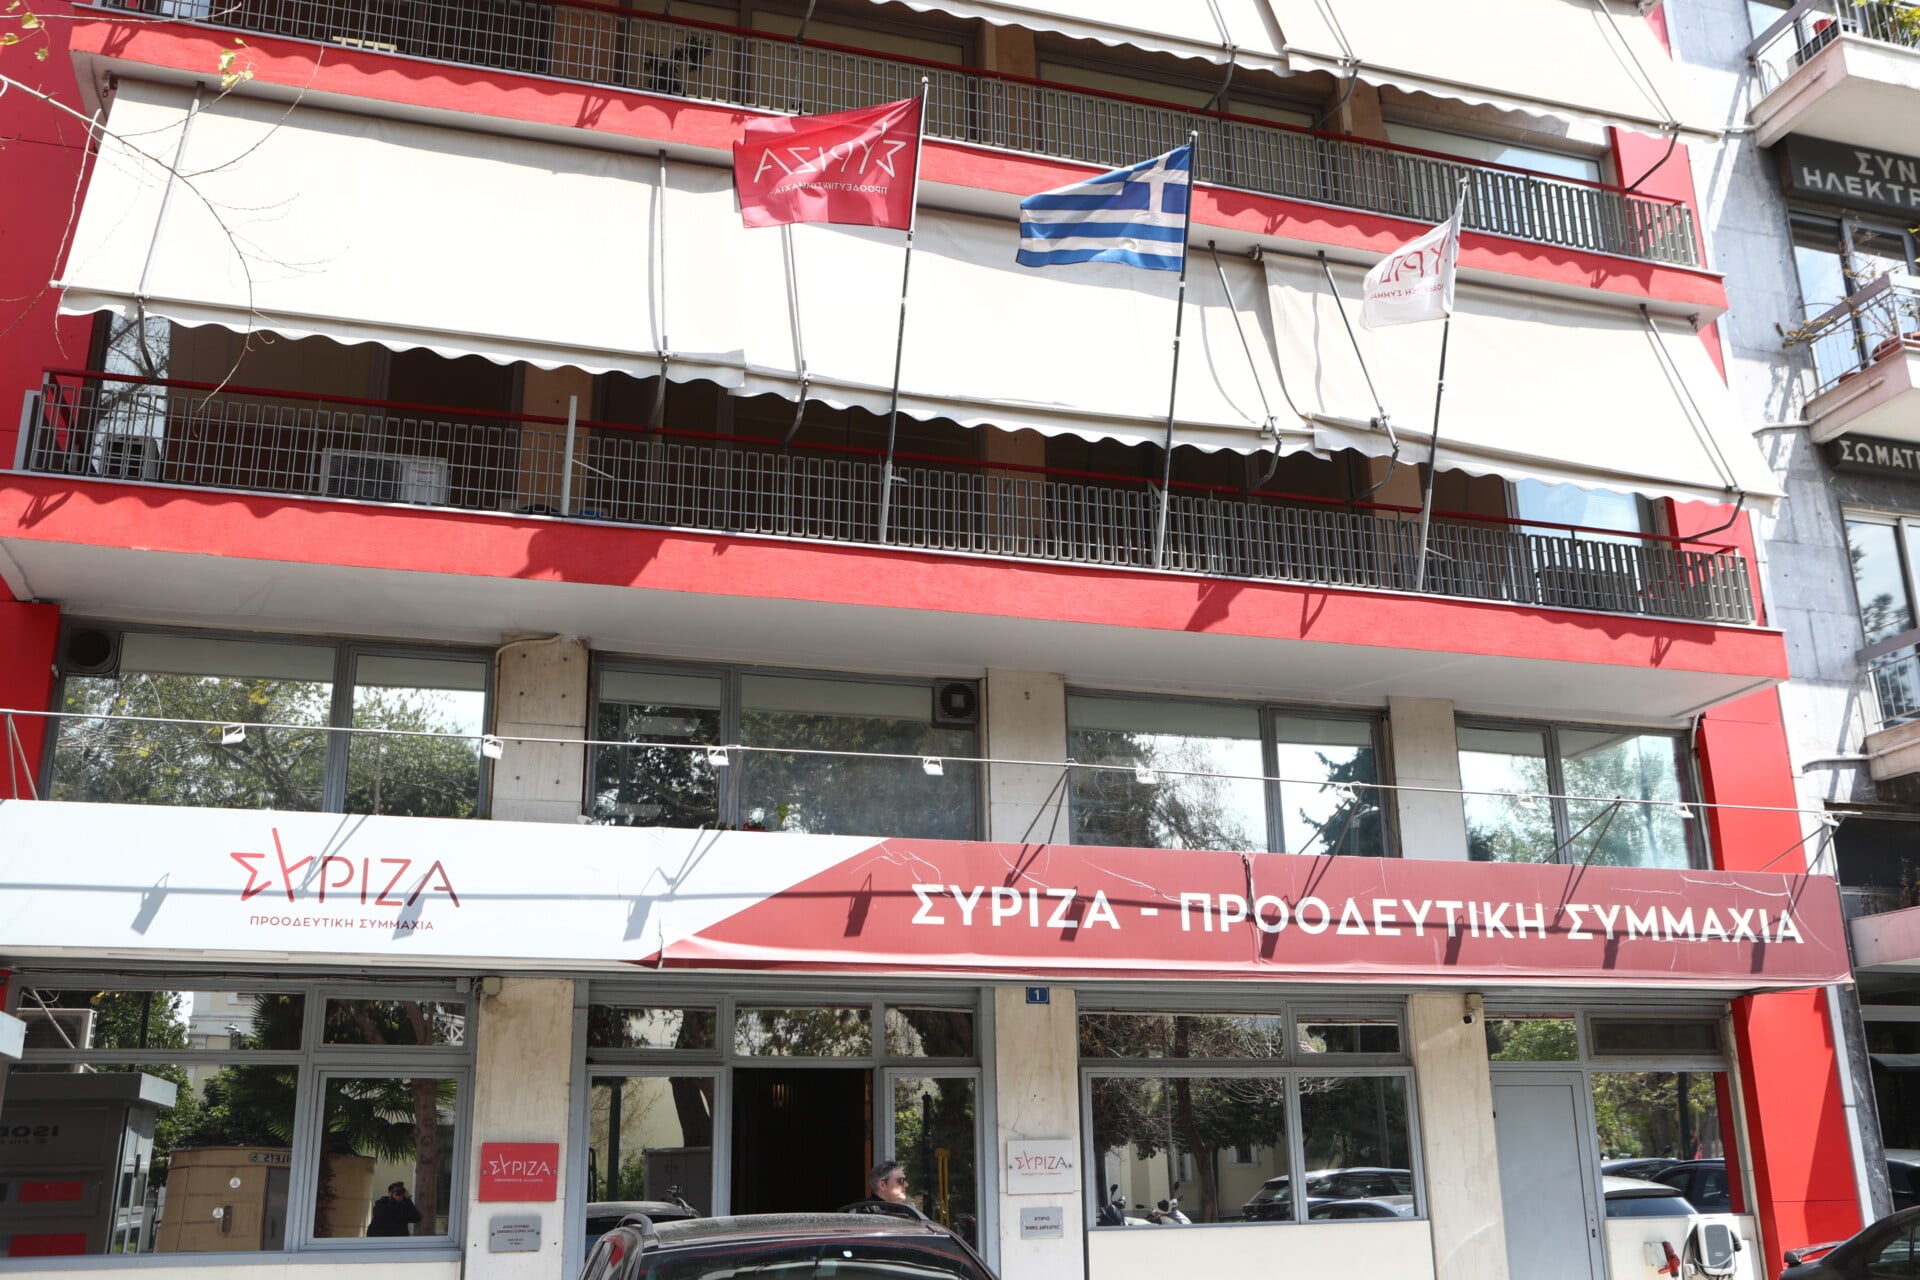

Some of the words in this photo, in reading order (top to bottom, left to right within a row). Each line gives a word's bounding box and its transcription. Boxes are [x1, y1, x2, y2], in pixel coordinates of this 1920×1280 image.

[1854, 151, 1918, 184] ΣΥΝ
[230, 827, 460, 908] ΣΥΡΙΖΑ
[250, 915, 354, 929] ΠΡΟΟΔΕΥΤΙΚΗ
[359, 918, 434, 930] ΣΥΜΜΑΧΙΑ
[911, 883, 1121, 930] ΣΥΡΙΖΑ
[1179, 892, 1547, 939] ΠΡΟΟΔΕΥΤΙΚΗ
[1564, 903, 1804, 944] ΣΥΜΜΑΧΙΑ
[1033, 989, 1040, 1001] 1
[488, 1153, 551, 1176] ΣΥΡΙΖΑ
[1014, 1149, 1068, 1170] ΣΥΡΙΖΑ
